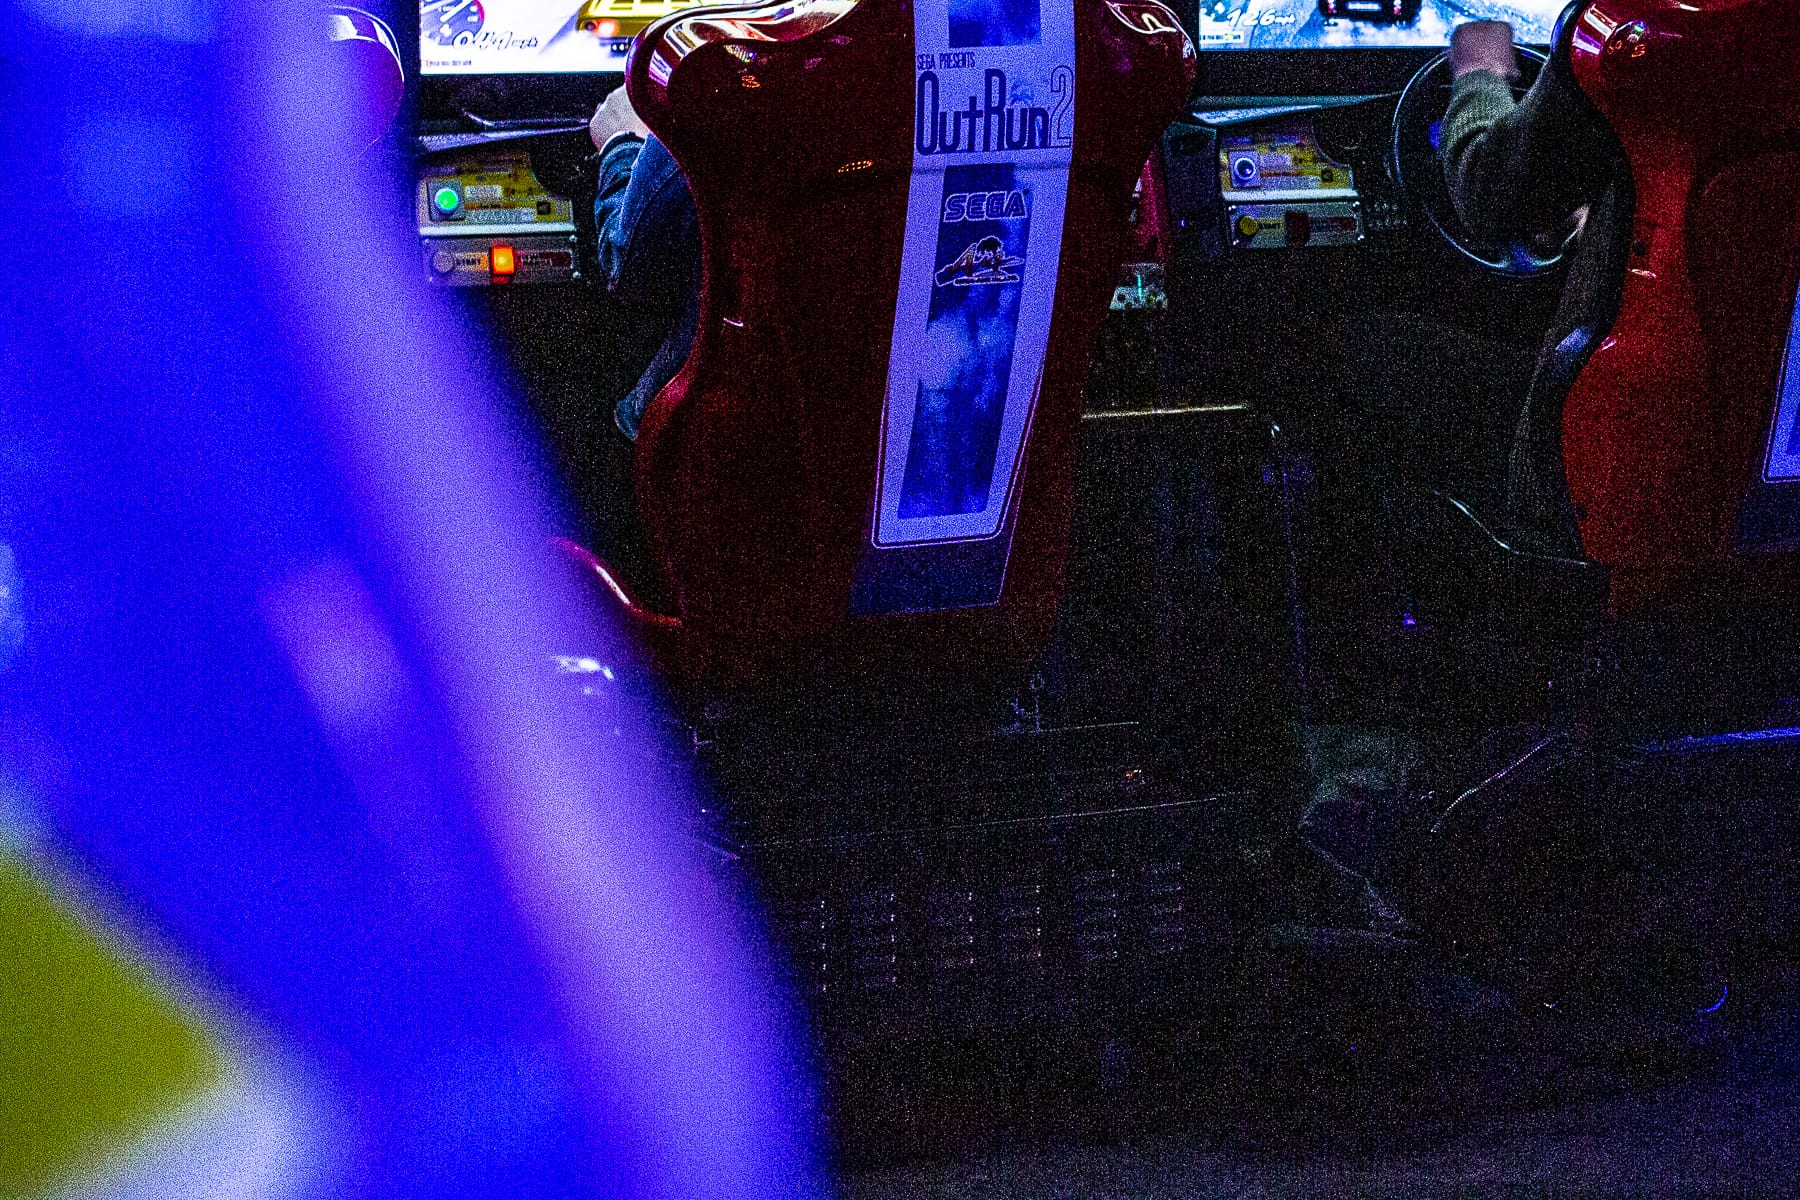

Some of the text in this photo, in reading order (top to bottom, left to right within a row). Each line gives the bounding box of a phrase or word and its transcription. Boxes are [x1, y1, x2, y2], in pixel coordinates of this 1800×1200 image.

[916, 51, 977, 70] SEGA PRESENTS
[915, 65, 1075, 156] OutRun2
[943, 191, 1028, 222] SEGA
